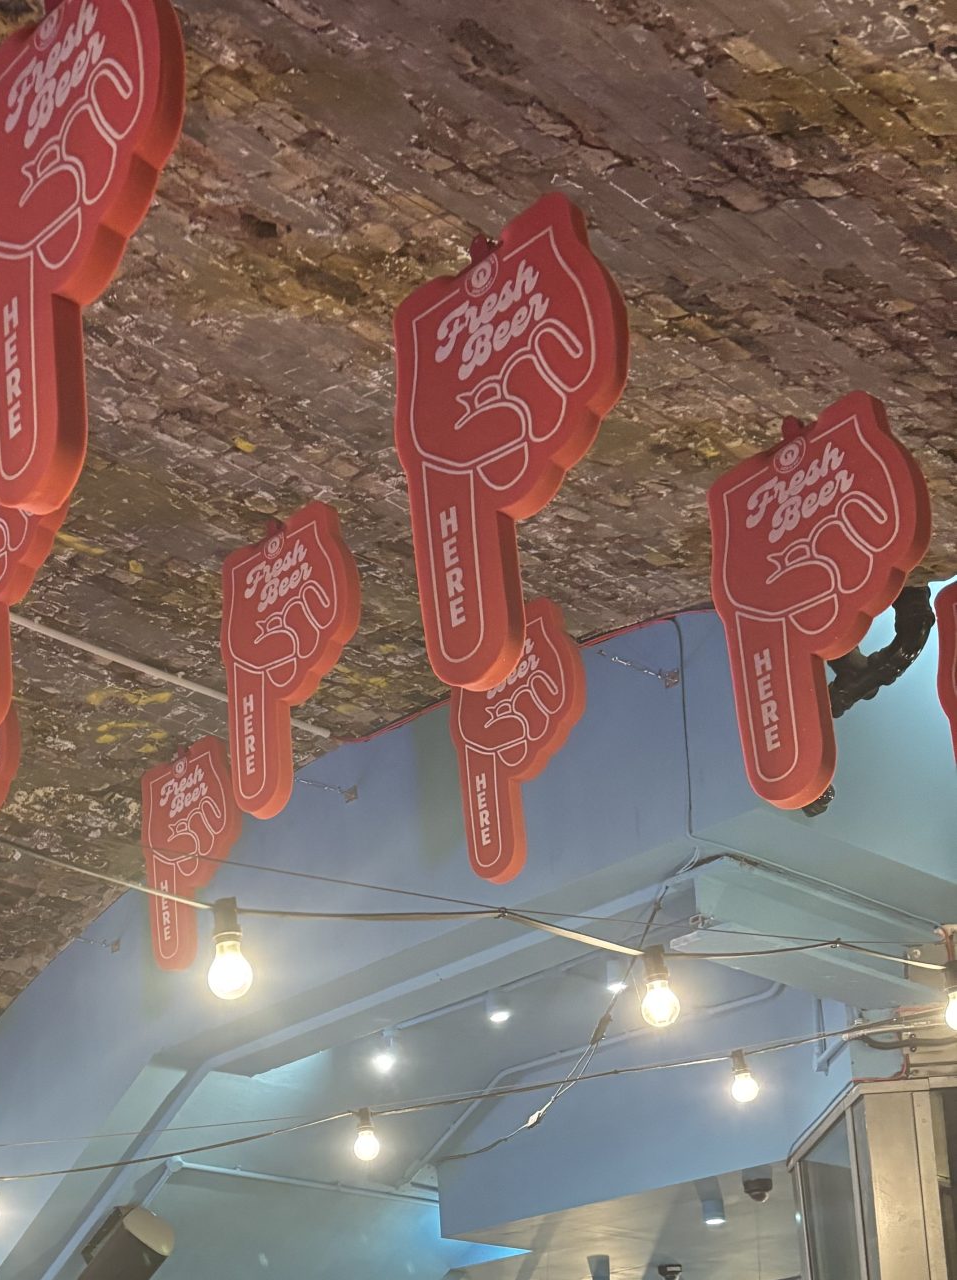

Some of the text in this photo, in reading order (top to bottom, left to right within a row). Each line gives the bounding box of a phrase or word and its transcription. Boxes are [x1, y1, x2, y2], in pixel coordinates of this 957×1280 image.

[24, 32, 105, 149] Beer
[435, 259, 539, 363] Fresh
[458, 292, 549, 381] Beer
[2, 297, 24, 439] HERE
[746, 442, 846, 529] Fresh
[768, 469, 855, 544] Beer
[244, 539, 308, 599] Fresh
[257, 562, 313, 613] Beer
[439, 505, 467, 628] HERE
[242, 694, 256, 776] HERE
[753, 648, 781, 752] HERE
[160, 764, 205, 807] Fresh
[169, 782, 208, 818] Beer
[474, 773, 491, 846] HERE
